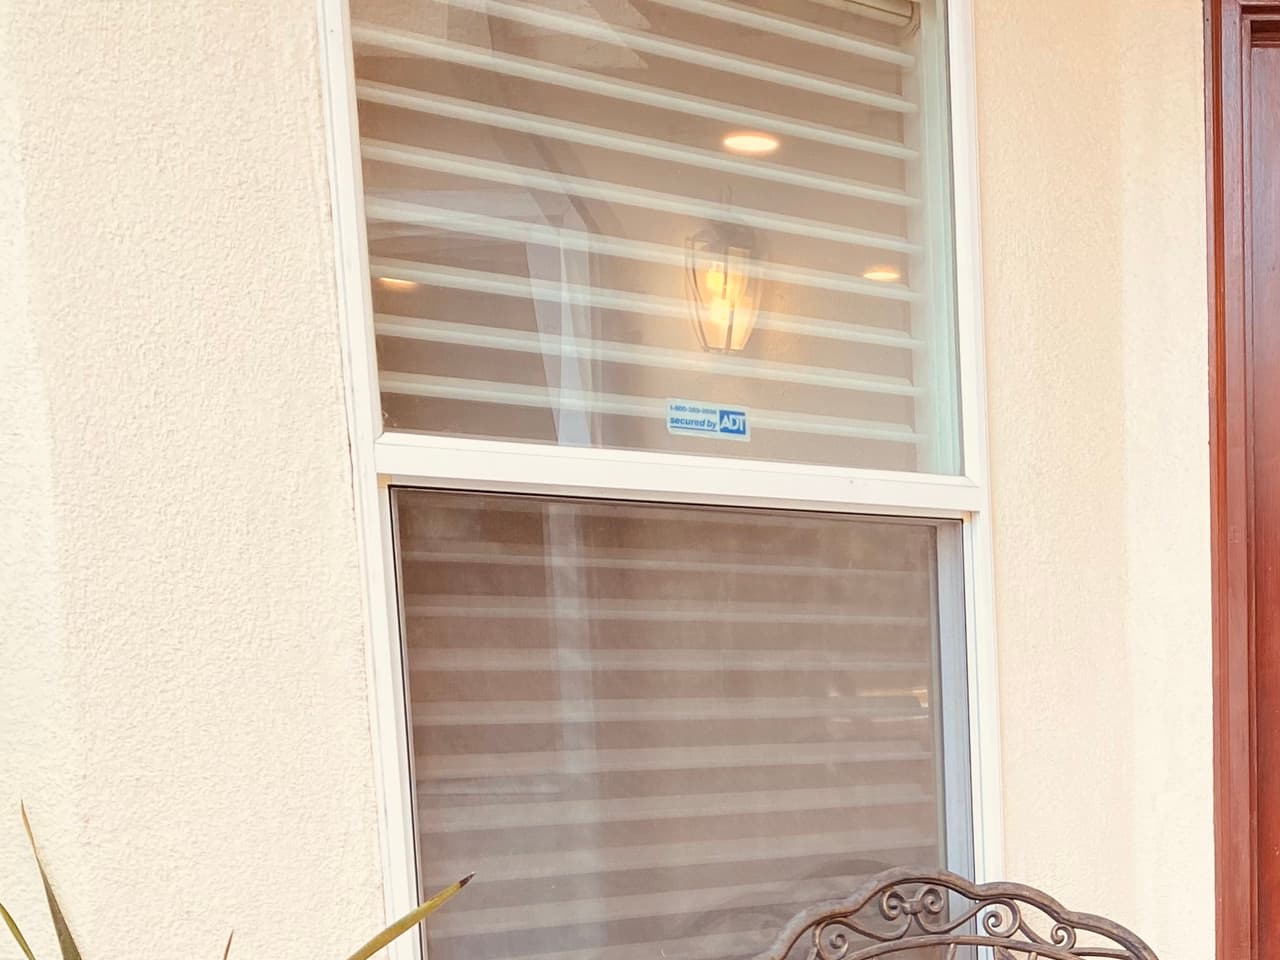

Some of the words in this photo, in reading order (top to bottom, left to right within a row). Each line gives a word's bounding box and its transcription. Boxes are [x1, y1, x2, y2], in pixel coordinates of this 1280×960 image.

[670, 417, 705, 427] secured
[707, 418, 717, 429] by
[719, 412, 745, 433] ADT
